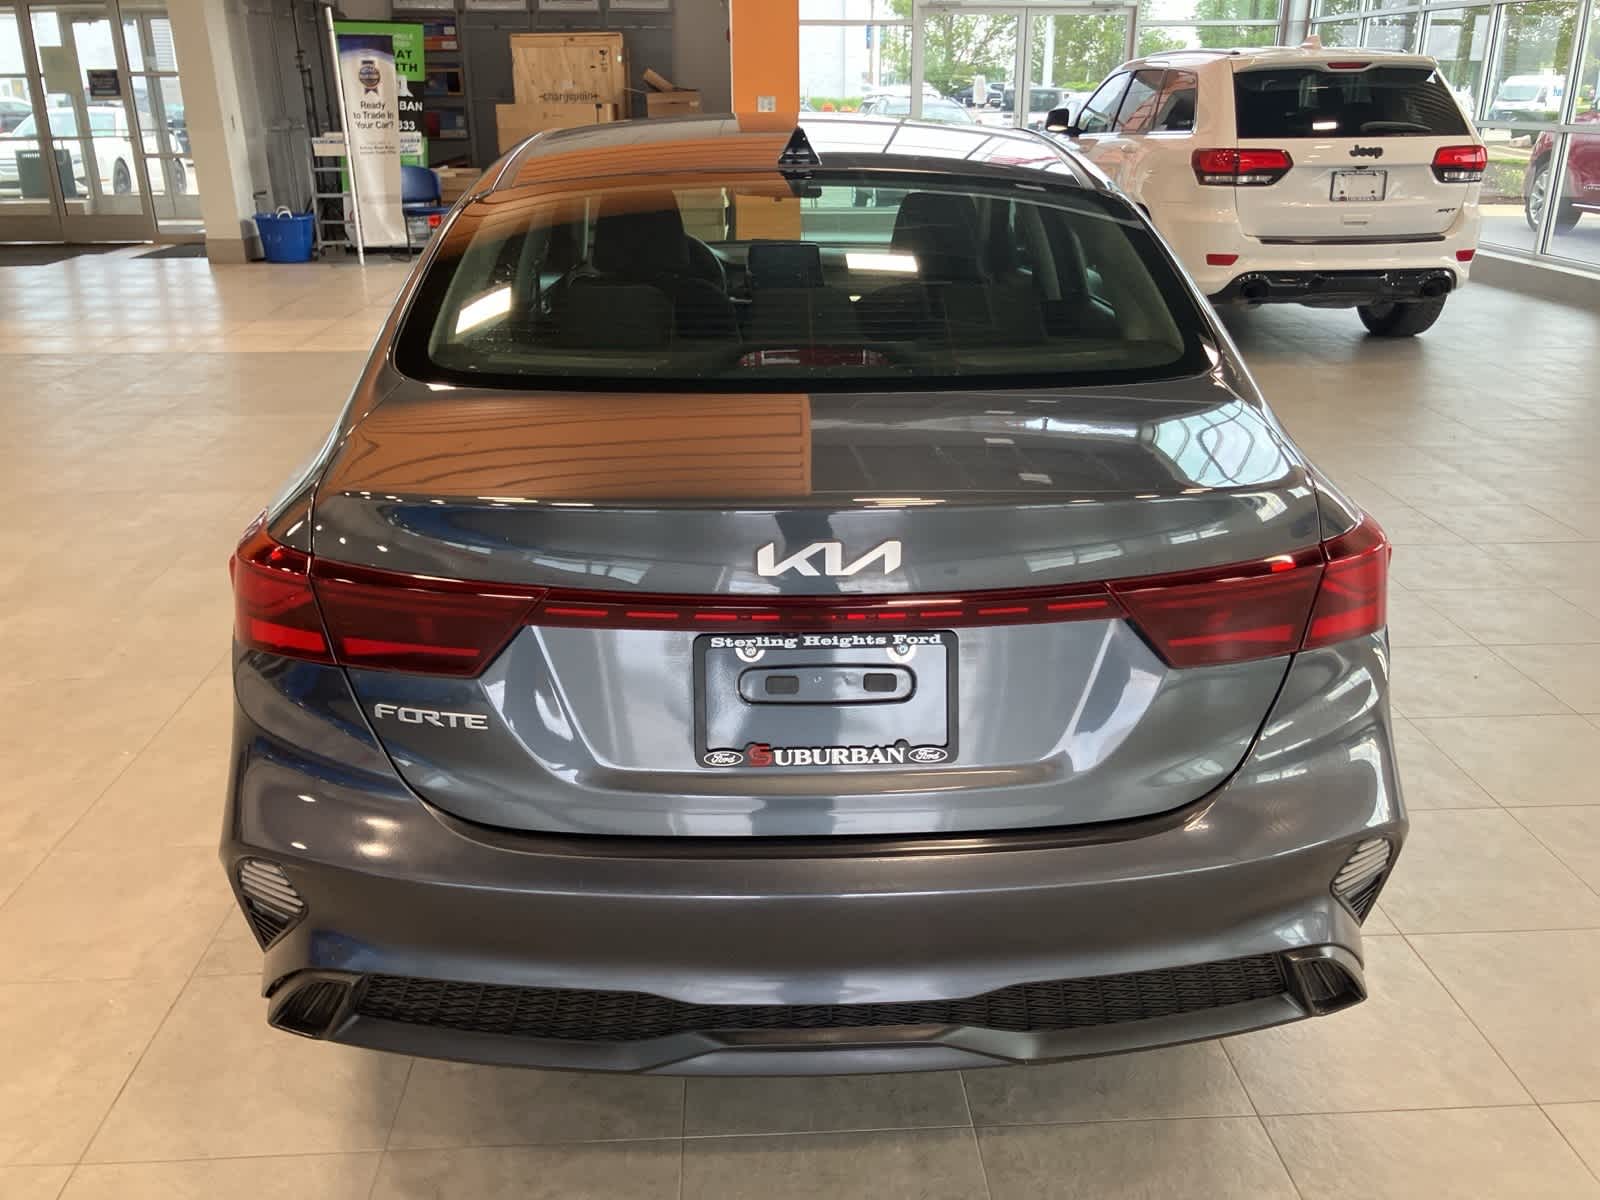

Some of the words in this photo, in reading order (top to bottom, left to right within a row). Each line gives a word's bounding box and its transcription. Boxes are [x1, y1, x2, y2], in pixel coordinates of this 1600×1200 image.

[360, 101, 385, 110] Ready
[363, 111, 386, 119] Trade
[1349, 145, 1383, 159] Jeep
[710, 637, 798, 648] Sterling
[803, 635, 887, 647] Heights
[892, 634, 942, 645] Ford
[374, 703, 489, 730] FORTE
[749, 744, 905, 767] SUBURBAN
